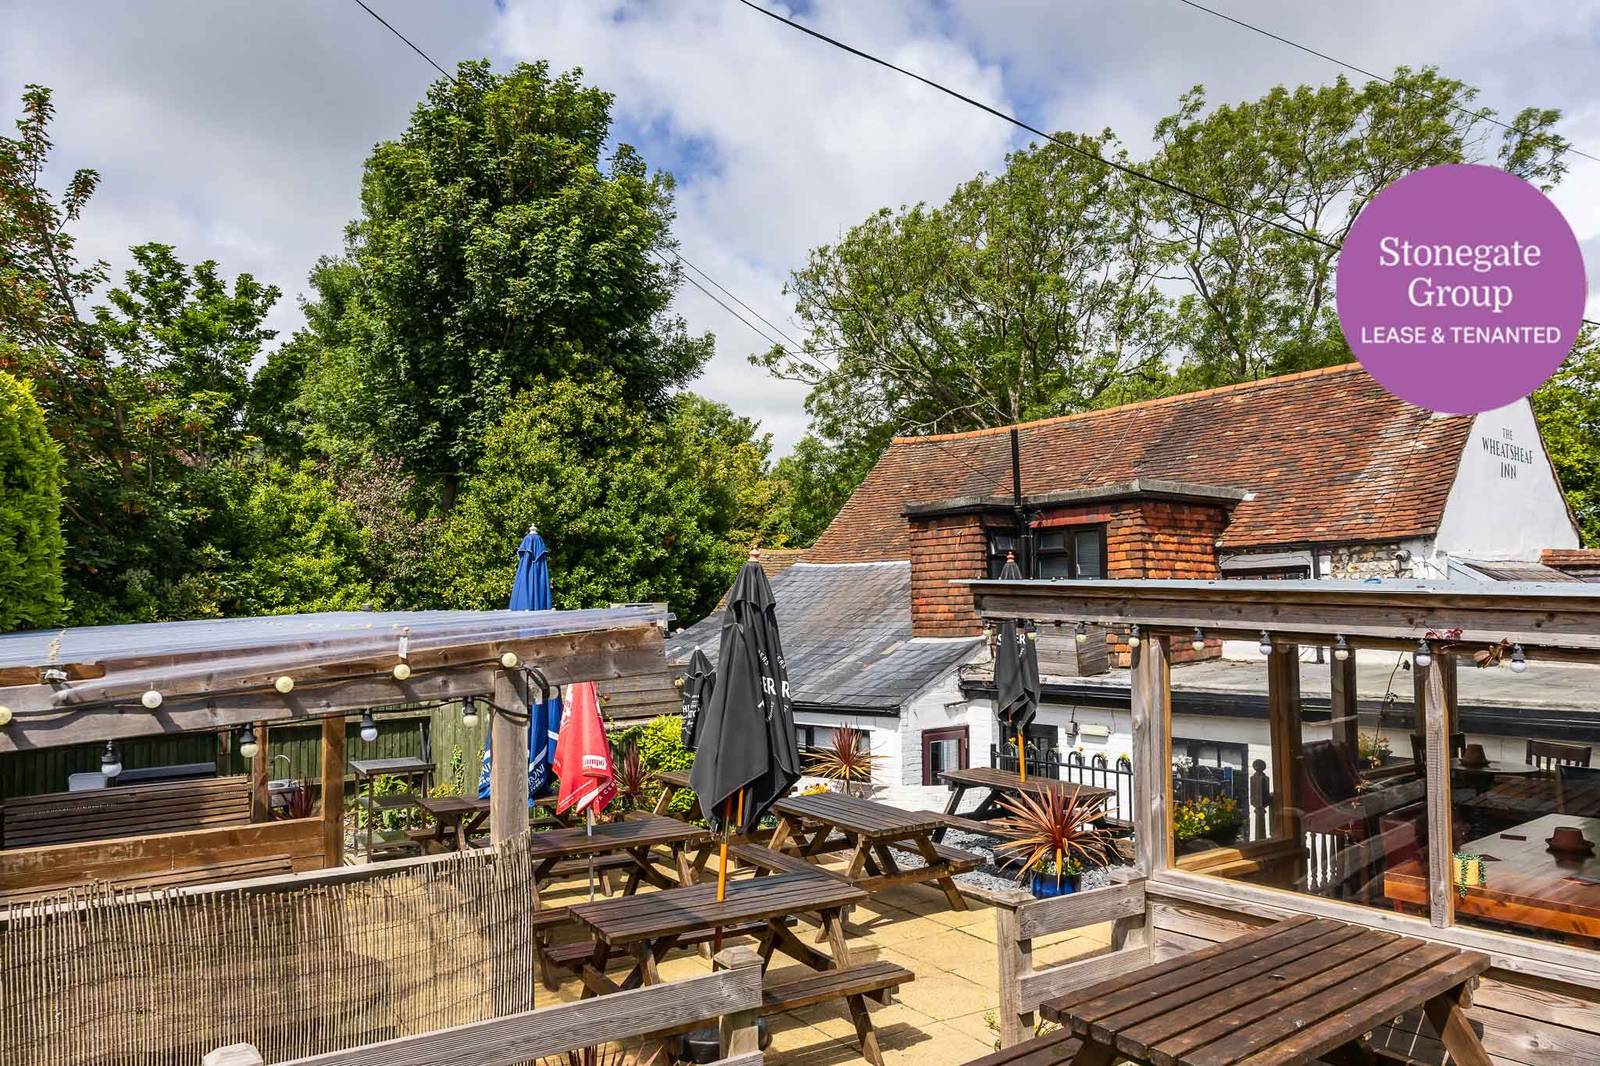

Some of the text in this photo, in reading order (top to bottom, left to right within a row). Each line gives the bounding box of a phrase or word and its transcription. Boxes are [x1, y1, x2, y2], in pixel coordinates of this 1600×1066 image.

[1502, 427, 1513, 441] THE
[1481, 436, 1534, 465] WHEATSHEAF
[1500, 461, 1517, 480] INN
